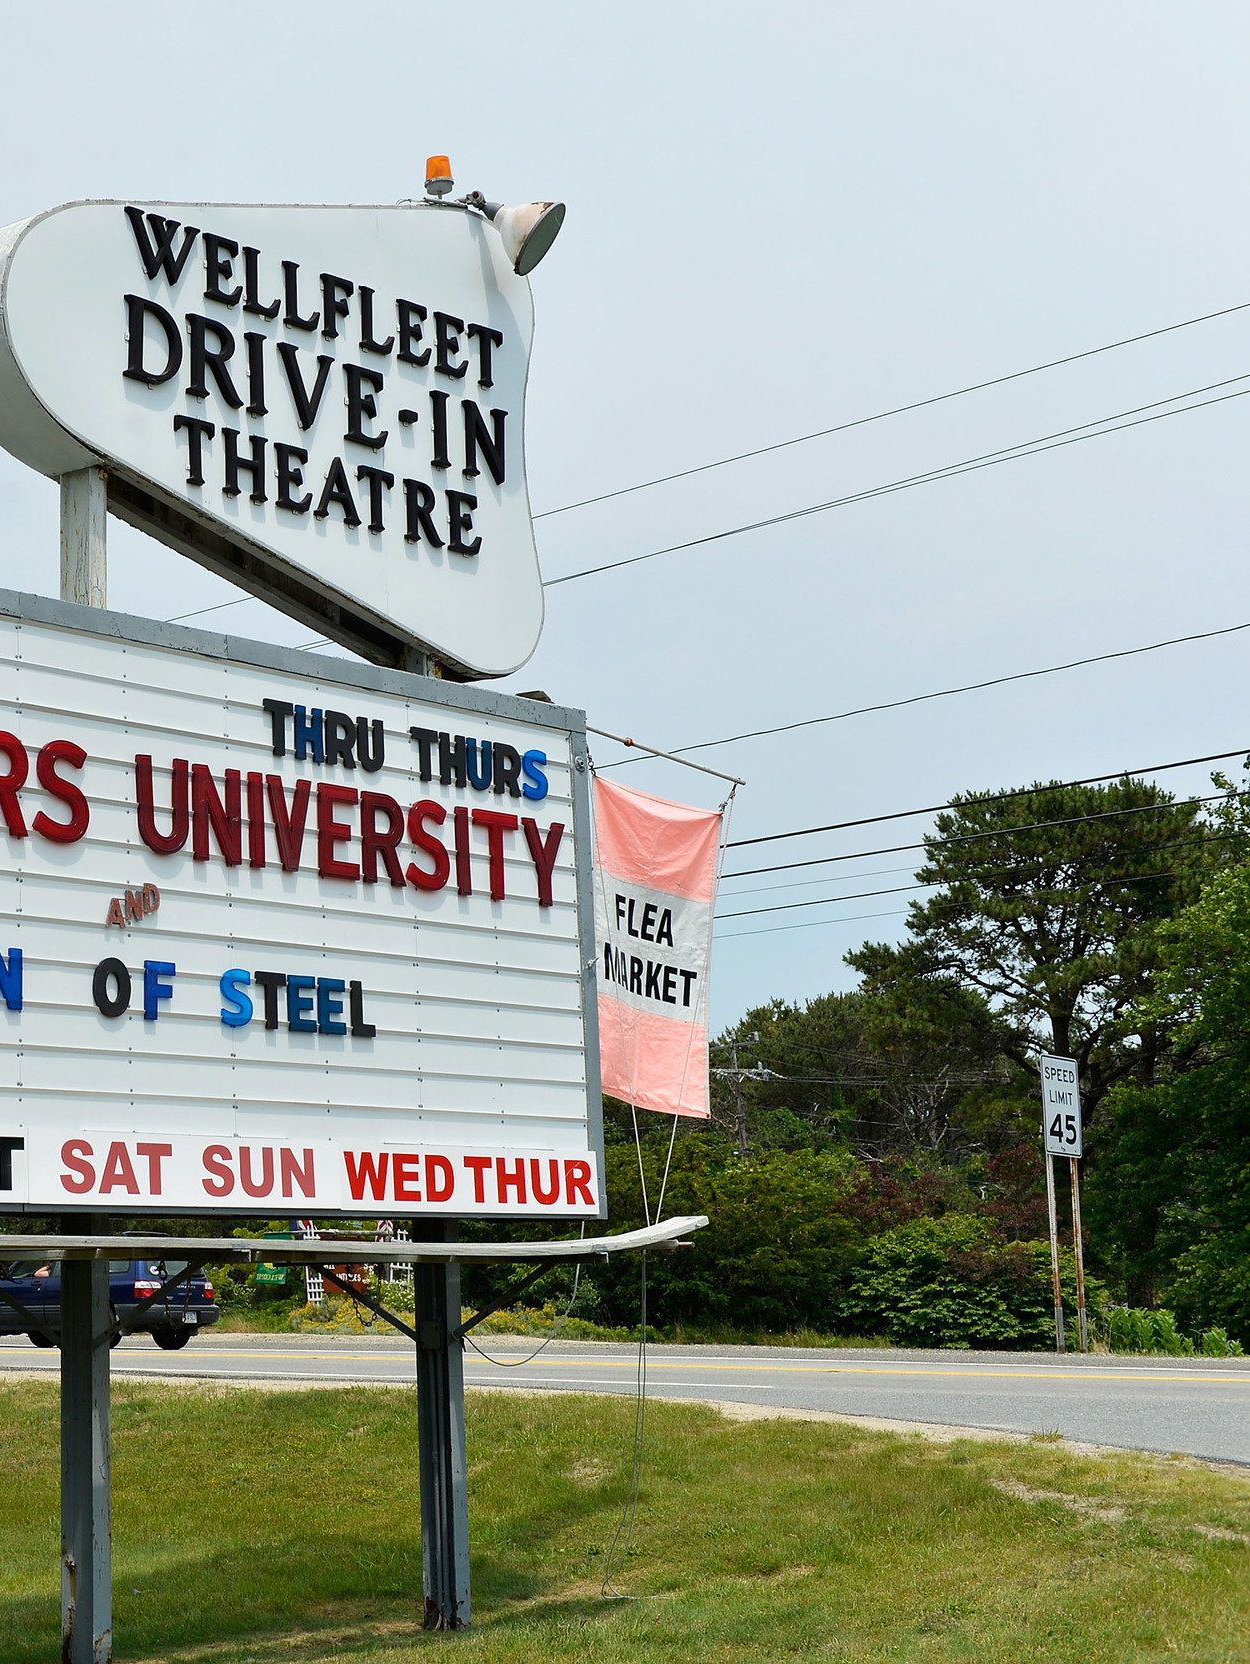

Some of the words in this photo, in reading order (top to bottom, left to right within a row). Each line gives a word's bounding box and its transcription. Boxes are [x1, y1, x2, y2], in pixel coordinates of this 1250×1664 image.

[124, 205, 504, 388] WELLFLEET
[122, 294, 508, 485] DRIVE-IN
[173, 414, 483, 556] THEATRE
[263, 698, 384, 772] THRU
[410, 726, 549, 801] THURS
[135, 754, 565, 907] UNIVERSITY
[105, 882, 161, 928] AND
[615, 893, 674, 948] FLEA
[93, 957, 176, 1020] OF
[220, 968, 377, 1038] STEEL
[604, 941, 698, 1008] MARKET
[1044, 1066, 1075, 1084] SPEED
[1049, 1089, 1073, 1106] LIMIT
[1049, 1113, 1077, 1146] 45
[59, 1138, 172, 1196] SAT
[201, 1144, 316, 1198] SUN
[343, 1150, 454, 1202] WED
[463, 1155, 596, 1205] THUR
